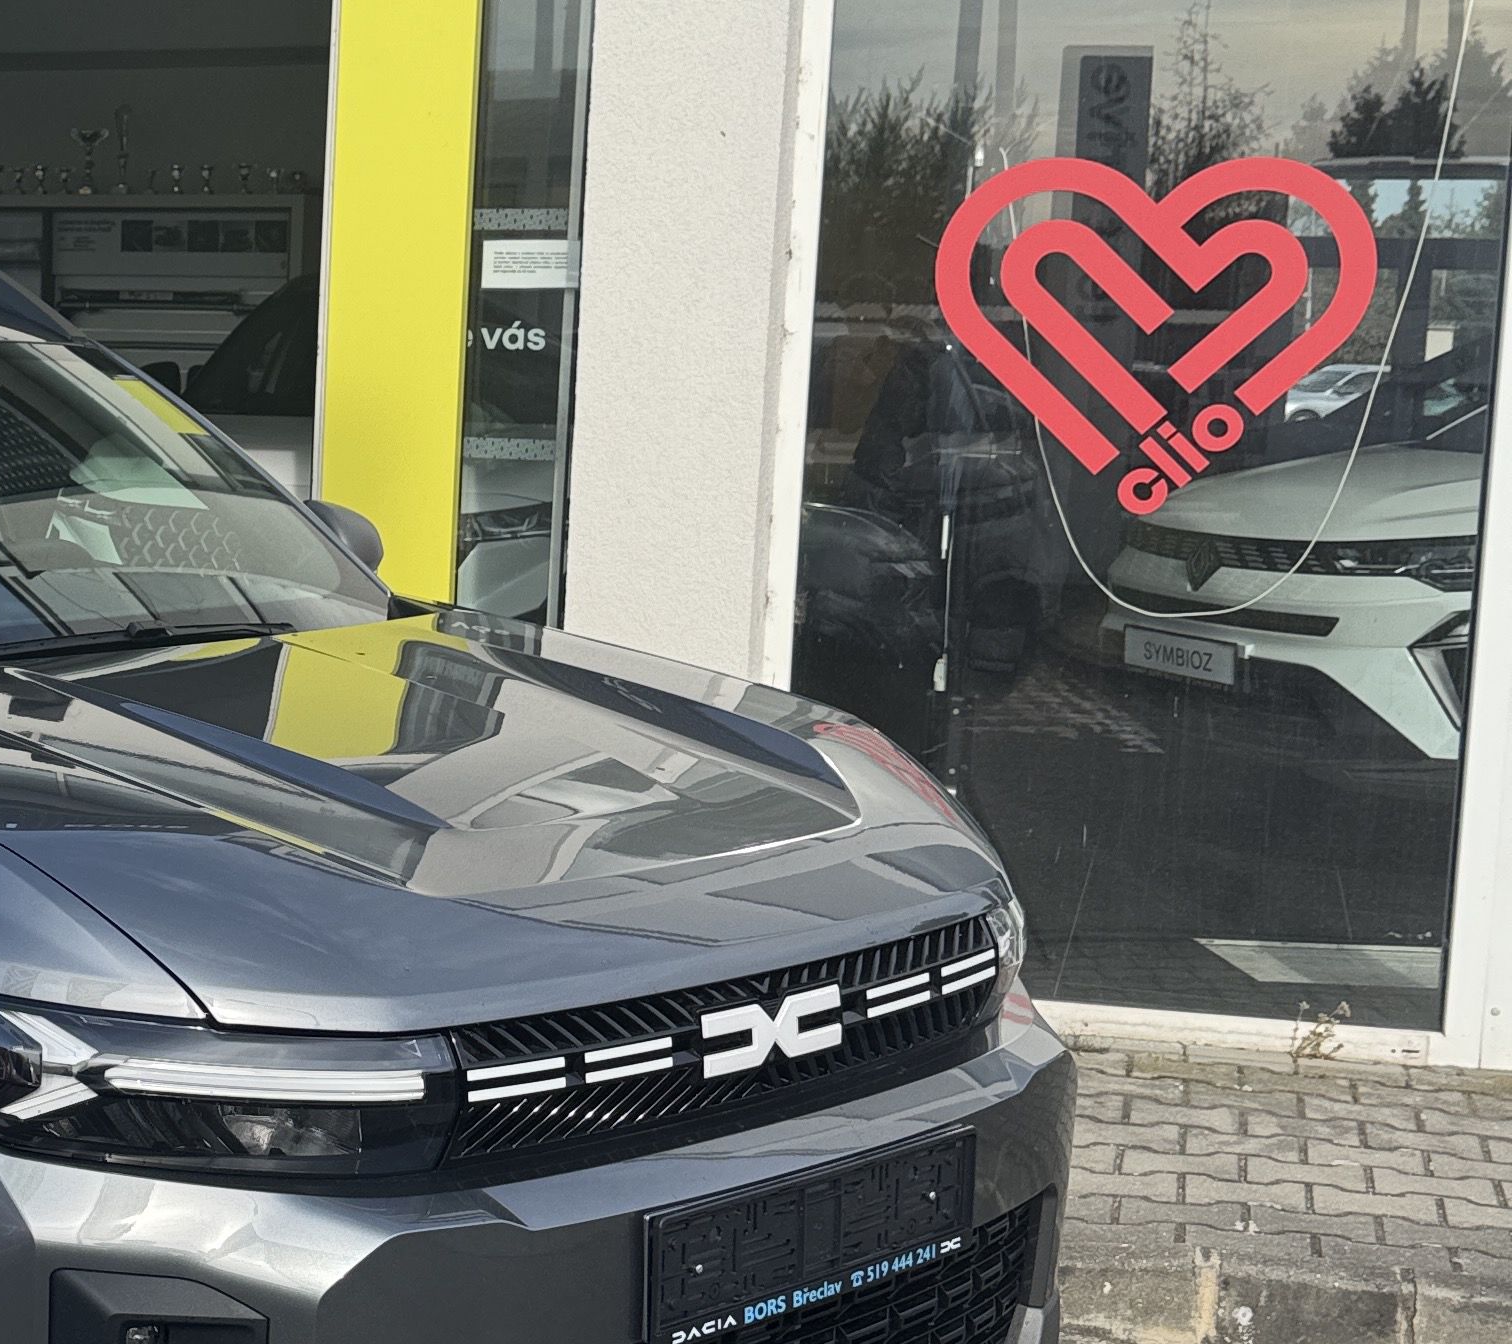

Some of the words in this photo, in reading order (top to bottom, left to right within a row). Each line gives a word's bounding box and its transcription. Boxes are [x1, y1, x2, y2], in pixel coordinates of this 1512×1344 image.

[480, 320, 546, 351] vás
[1117, 403, 1245, 515] clio
[1143, 641, 1214, 673] SYMBIOZ
[743, 1295, 787, 1325] BORS
[792, 1280, 843, 1308] Břeclav
[866, 1260, 889, 1283] 519
[891, 1251, 914, 1273] 444
[916, 1243, 937, 1265] 241
